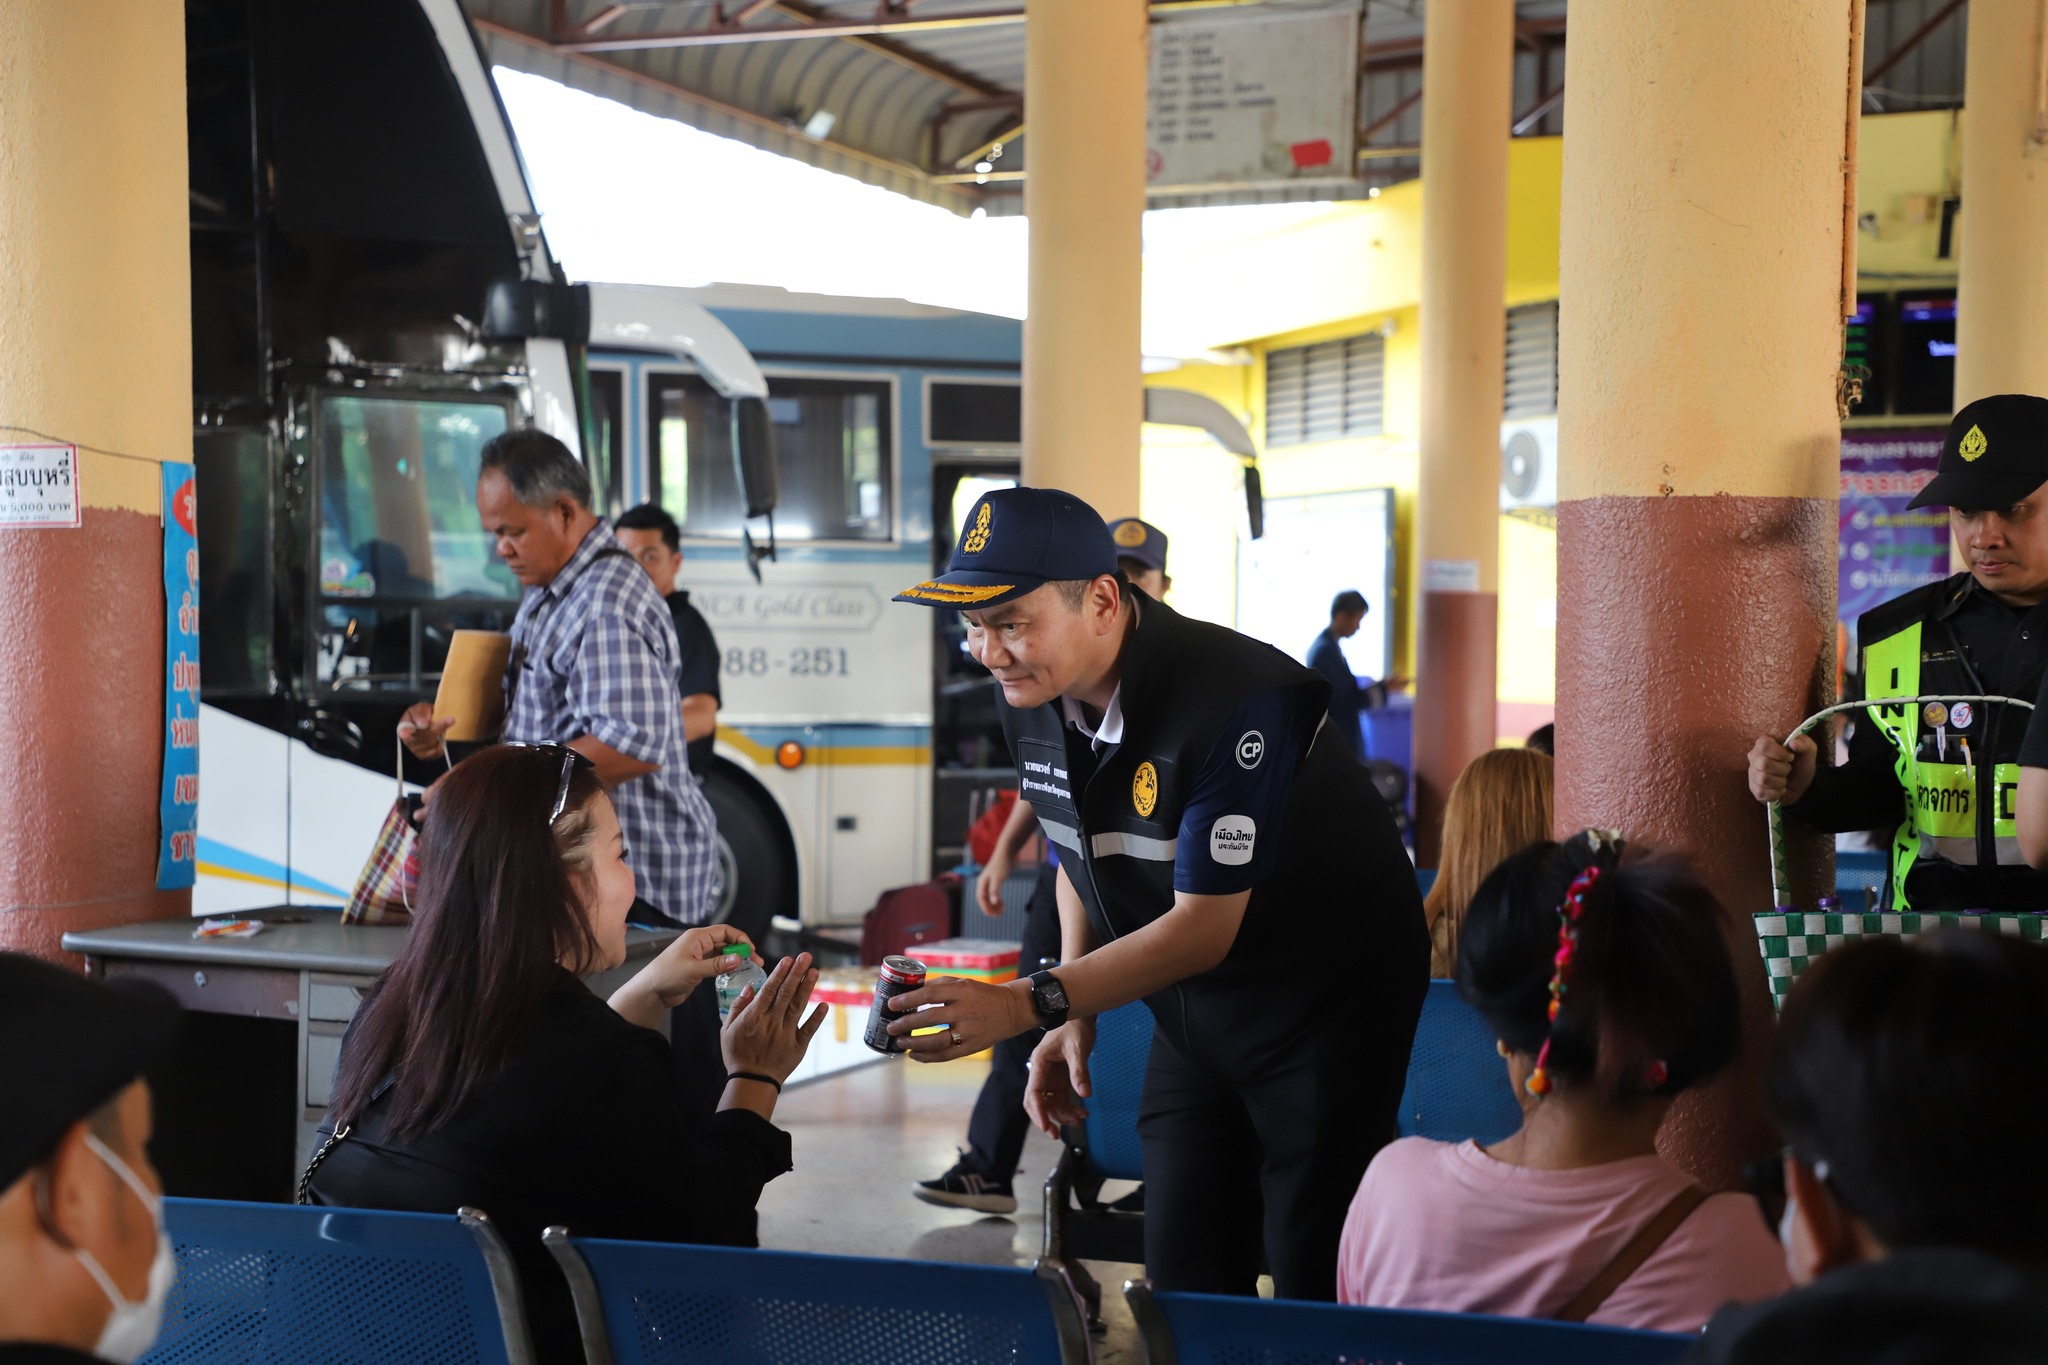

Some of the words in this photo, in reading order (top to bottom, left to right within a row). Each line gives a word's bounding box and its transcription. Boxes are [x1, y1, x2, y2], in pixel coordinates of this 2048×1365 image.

[11, 502, 43, 513] 5,000
[48, 502, 71, 511] บาท
[753, 590, 801, 621] Gold
[809, 591, 864, 618] Class
[1241, 742, 1261, 759] CP
[1215, 828, 1254, 841] เมืองไทย
